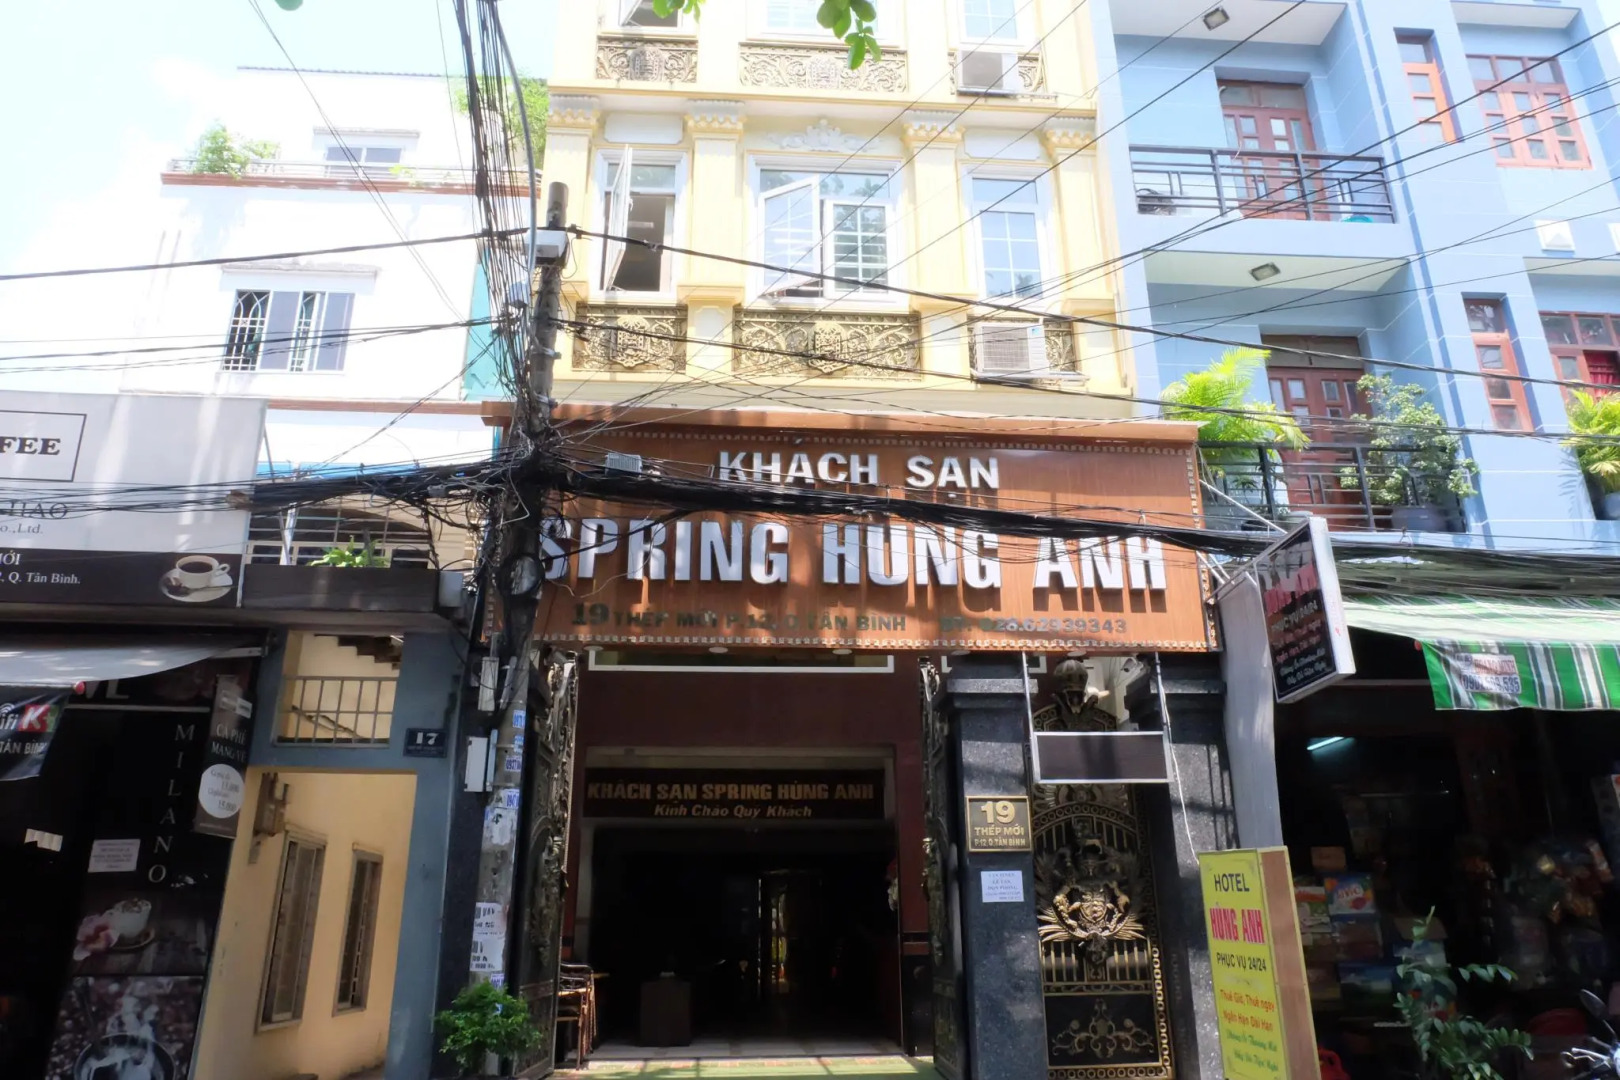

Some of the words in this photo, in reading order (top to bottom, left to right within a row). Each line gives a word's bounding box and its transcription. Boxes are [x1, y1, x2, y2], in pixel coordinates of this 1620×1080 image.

[539, 518, 790, 586] SPRING
[1034, 536, 1167, 590] ANH
[571, 602, 610, 626] 19
[416, 732, 440, 745] 17
[701, 783, 772, 800] SPRING
[834, 783, 874, 800] ANH
[980, 800, 1016, 824] 19
[974, 824, 1001, 836] THÉP
[1213, 873, 1250, 892] HOTEL
